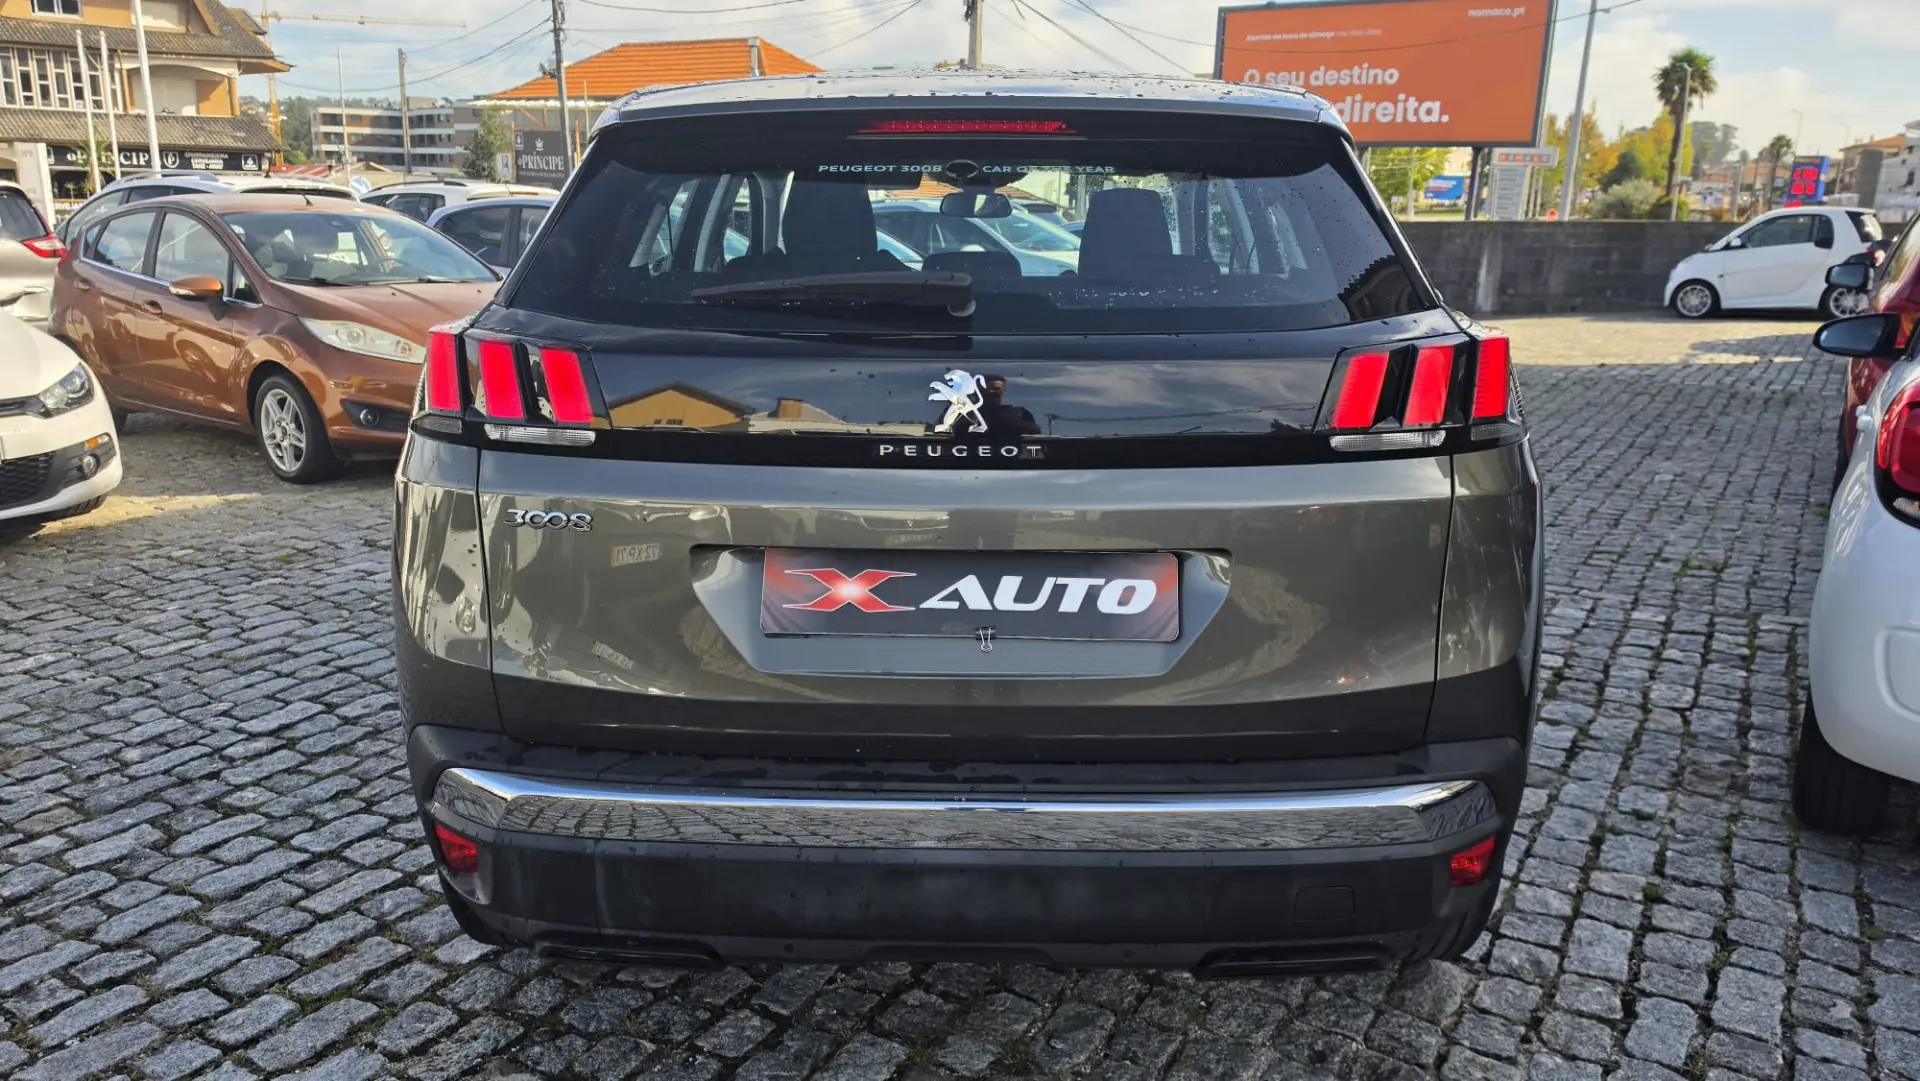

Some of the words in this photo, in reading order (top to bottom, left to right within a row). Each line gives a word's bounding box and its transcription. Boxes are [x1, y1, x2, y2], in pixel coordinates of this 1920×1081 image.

[1265, 70, 1305, 87] seu
[1309, 63, 1399, 87] destino
[1334, 93, 1450, 124] direita.
[818, 164, 897, 173] PEUGEOT
[900, 164, 943, 173] 3008
[982, 165, 1012, 173] CAR
[1074, 165, 1116, 174] YEAR
[879, 445, 1042, 458] PEUGEOT
[503, 508, 593, 533] 3008
[919, 574, 1158, 615] AUTO
